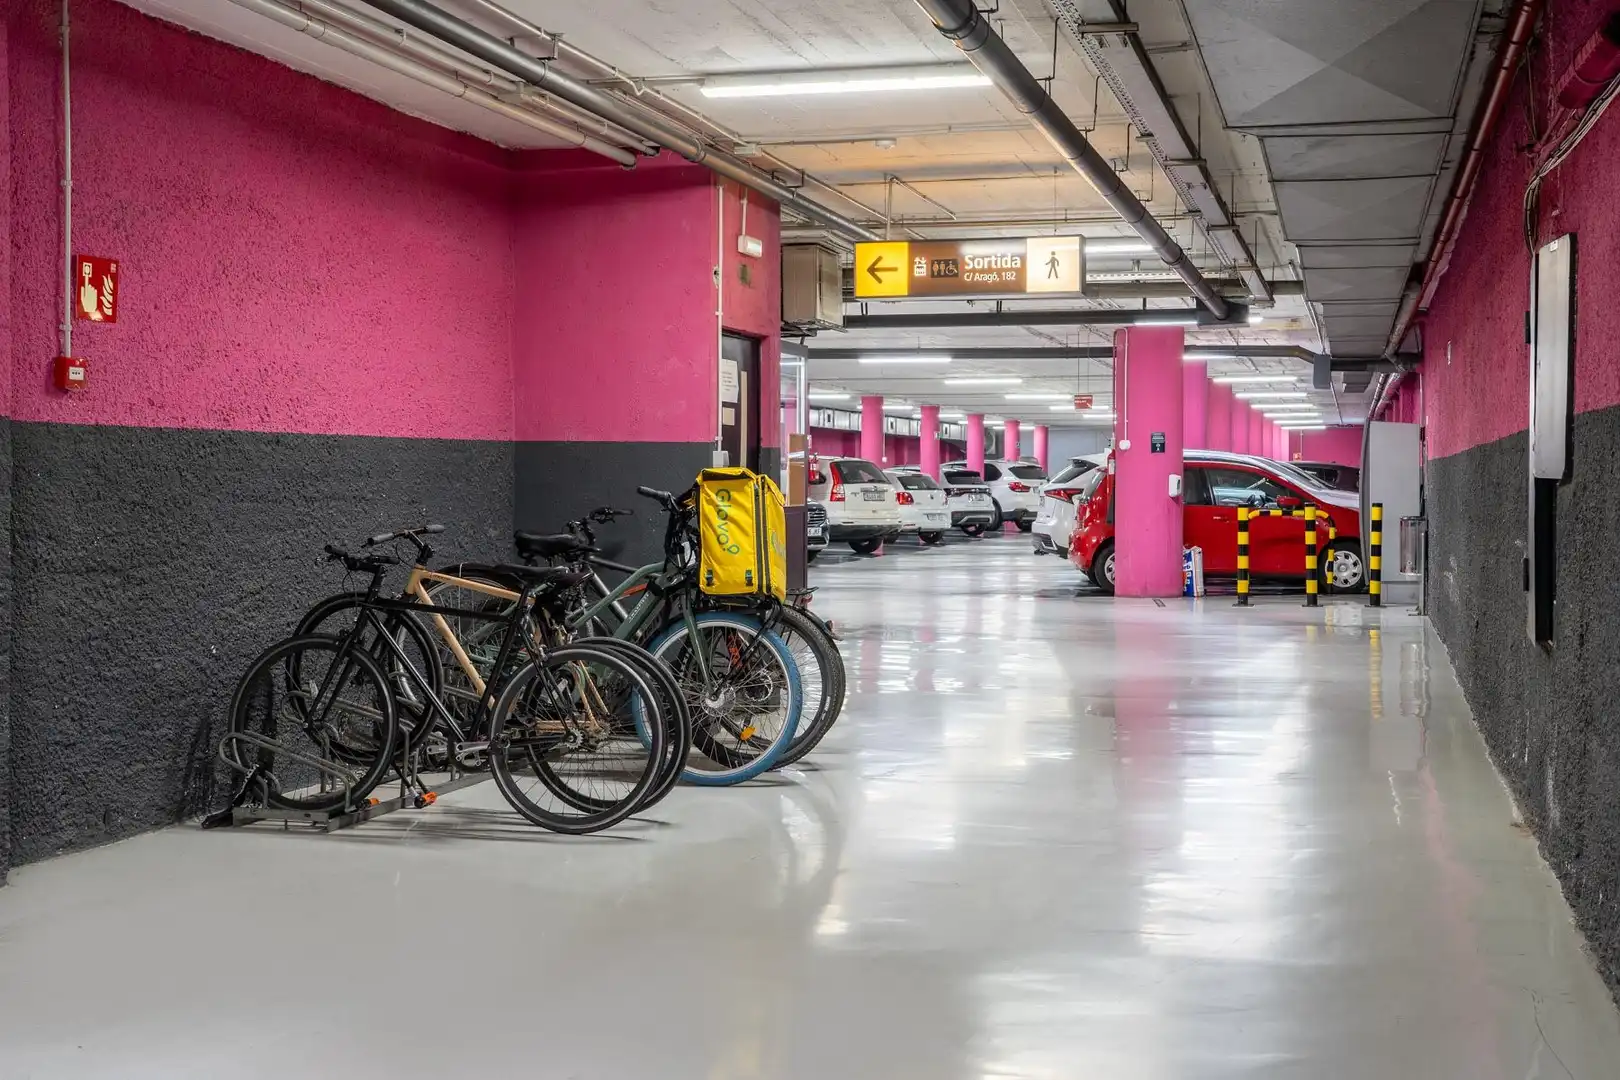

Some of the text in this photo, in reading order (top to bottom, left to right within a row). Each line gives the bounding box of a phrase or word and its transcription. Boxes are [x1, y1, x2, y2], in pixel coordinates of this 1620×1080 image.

[964, 253, 1021, 269] Sortida
[964, 271, 1016, 283] C/ Aragó, 182
